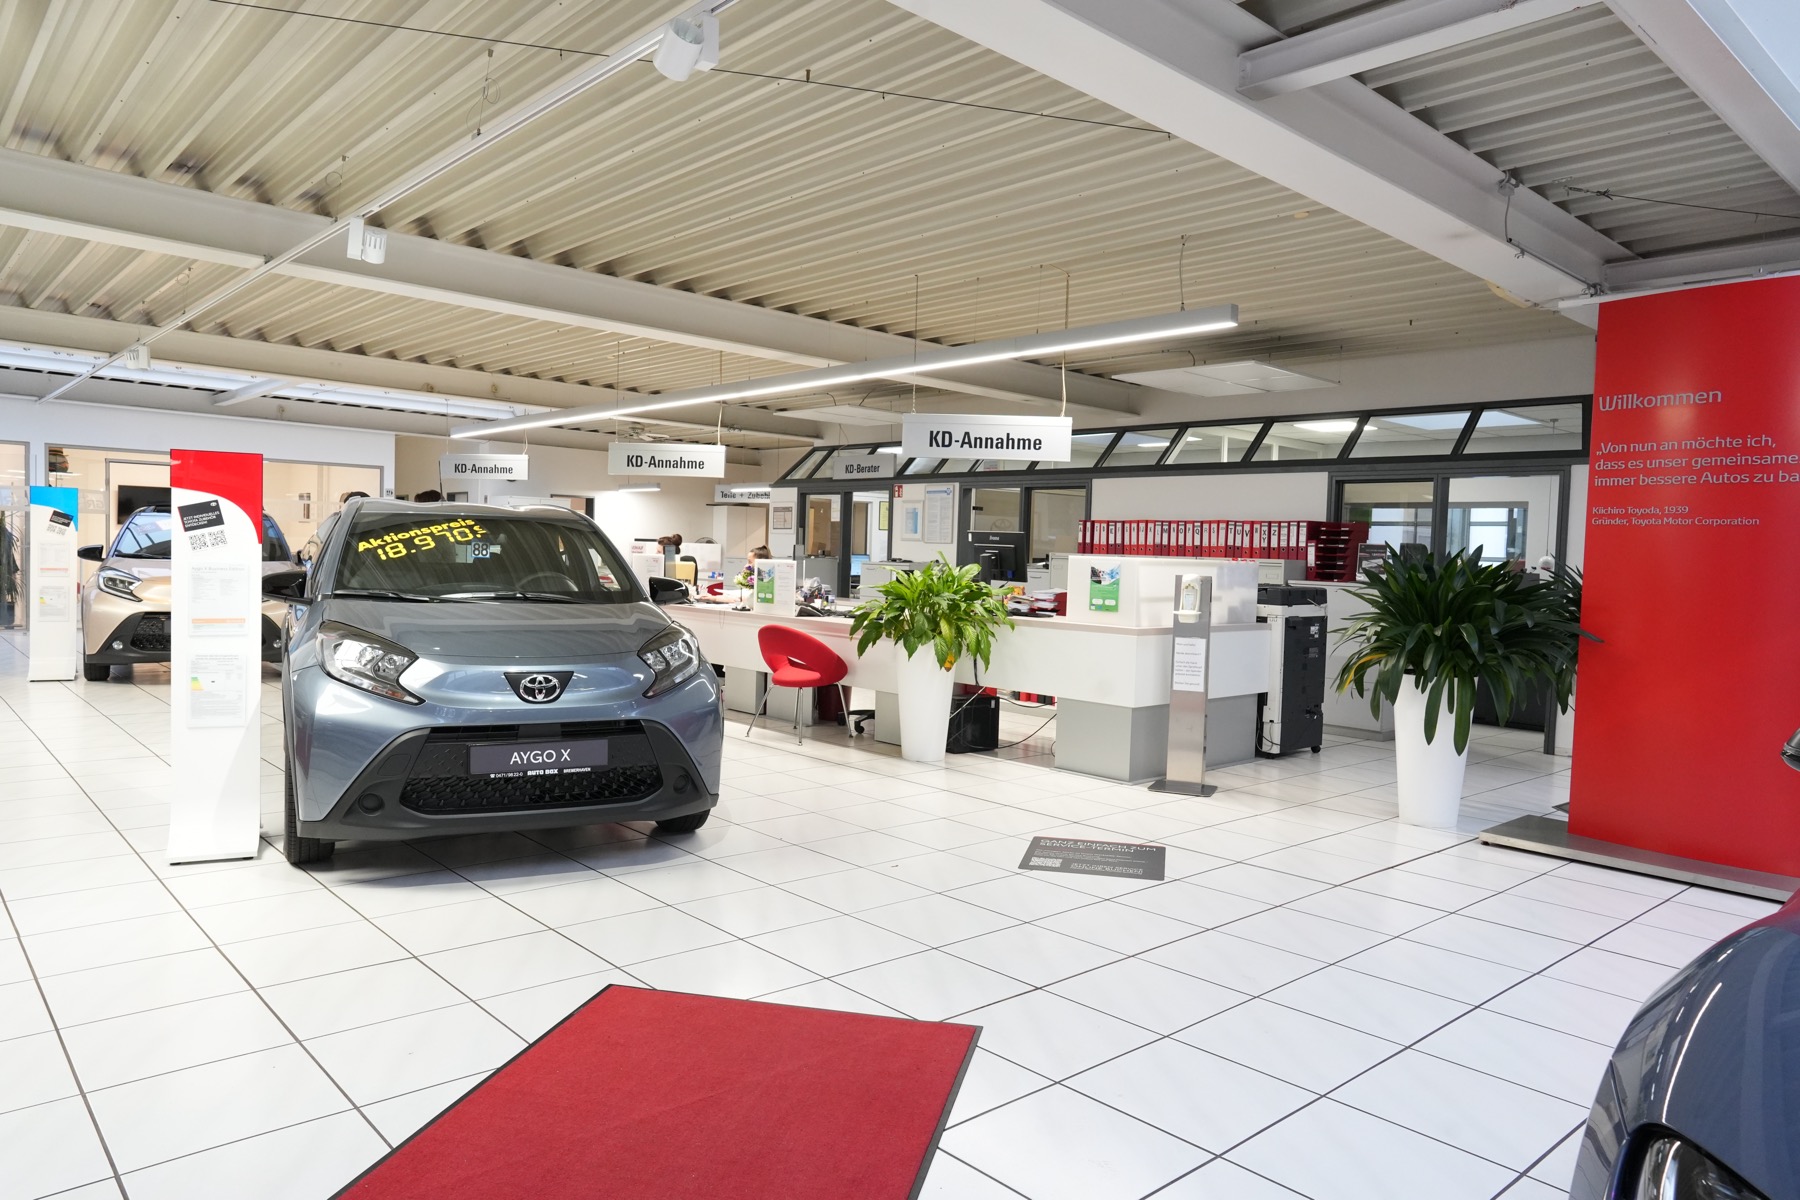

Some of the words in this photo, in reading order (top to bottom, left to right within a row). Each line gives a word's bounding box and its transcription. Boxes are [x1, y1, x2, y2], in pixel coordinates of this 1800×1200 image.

[1598, 390, 1722, 412] Willkommen
[929, 430, 1042, 451] KD-Annahme
[1630, 443, 1657, 452] nun
[1660, 441, 1678, 450] an
[1681, 436, 1742, 450] möchte
[1746, 434, 1776, 448] ich,
[454, 463, 513, 475] KD-Annahme
[626, 454, 705, 470] KD-Annahme
[845, 463, 880, 474] KD-Berater
[1595, 459, 1625, 470] dass
[1628, 460, 1643, 469] es
[1646, 457, 1688, 469] unser
[1691, 453, 1800, 470] gemeinsame
[1594, 475, 1637, 487] immer
[1639, 473, 1697, 486] bessere
[1700, 471, 1750, 484] Autos
[1753, 473, 1774, 483] zu
[720, 490, 737, 499] Teile
[1592, 506, 1625, 515] Kiichiro
[1627, 506, 1662, 516] Toyoda,
[1664, 505, 1689, 514] 1939
[1592, 517, 1629, 526] Gründer,
[1632, 517, 1662, 527] Toyota
[1663, 517, 1693, 525] Motor
[1695, 516, 1760, 527] Corporation
[358, 519, 475, 552] Aktionspreis
[473, 542, 488, 557] 88
[510, 750, 556, 765] AYGO
[560, 748, 571, 761] X
